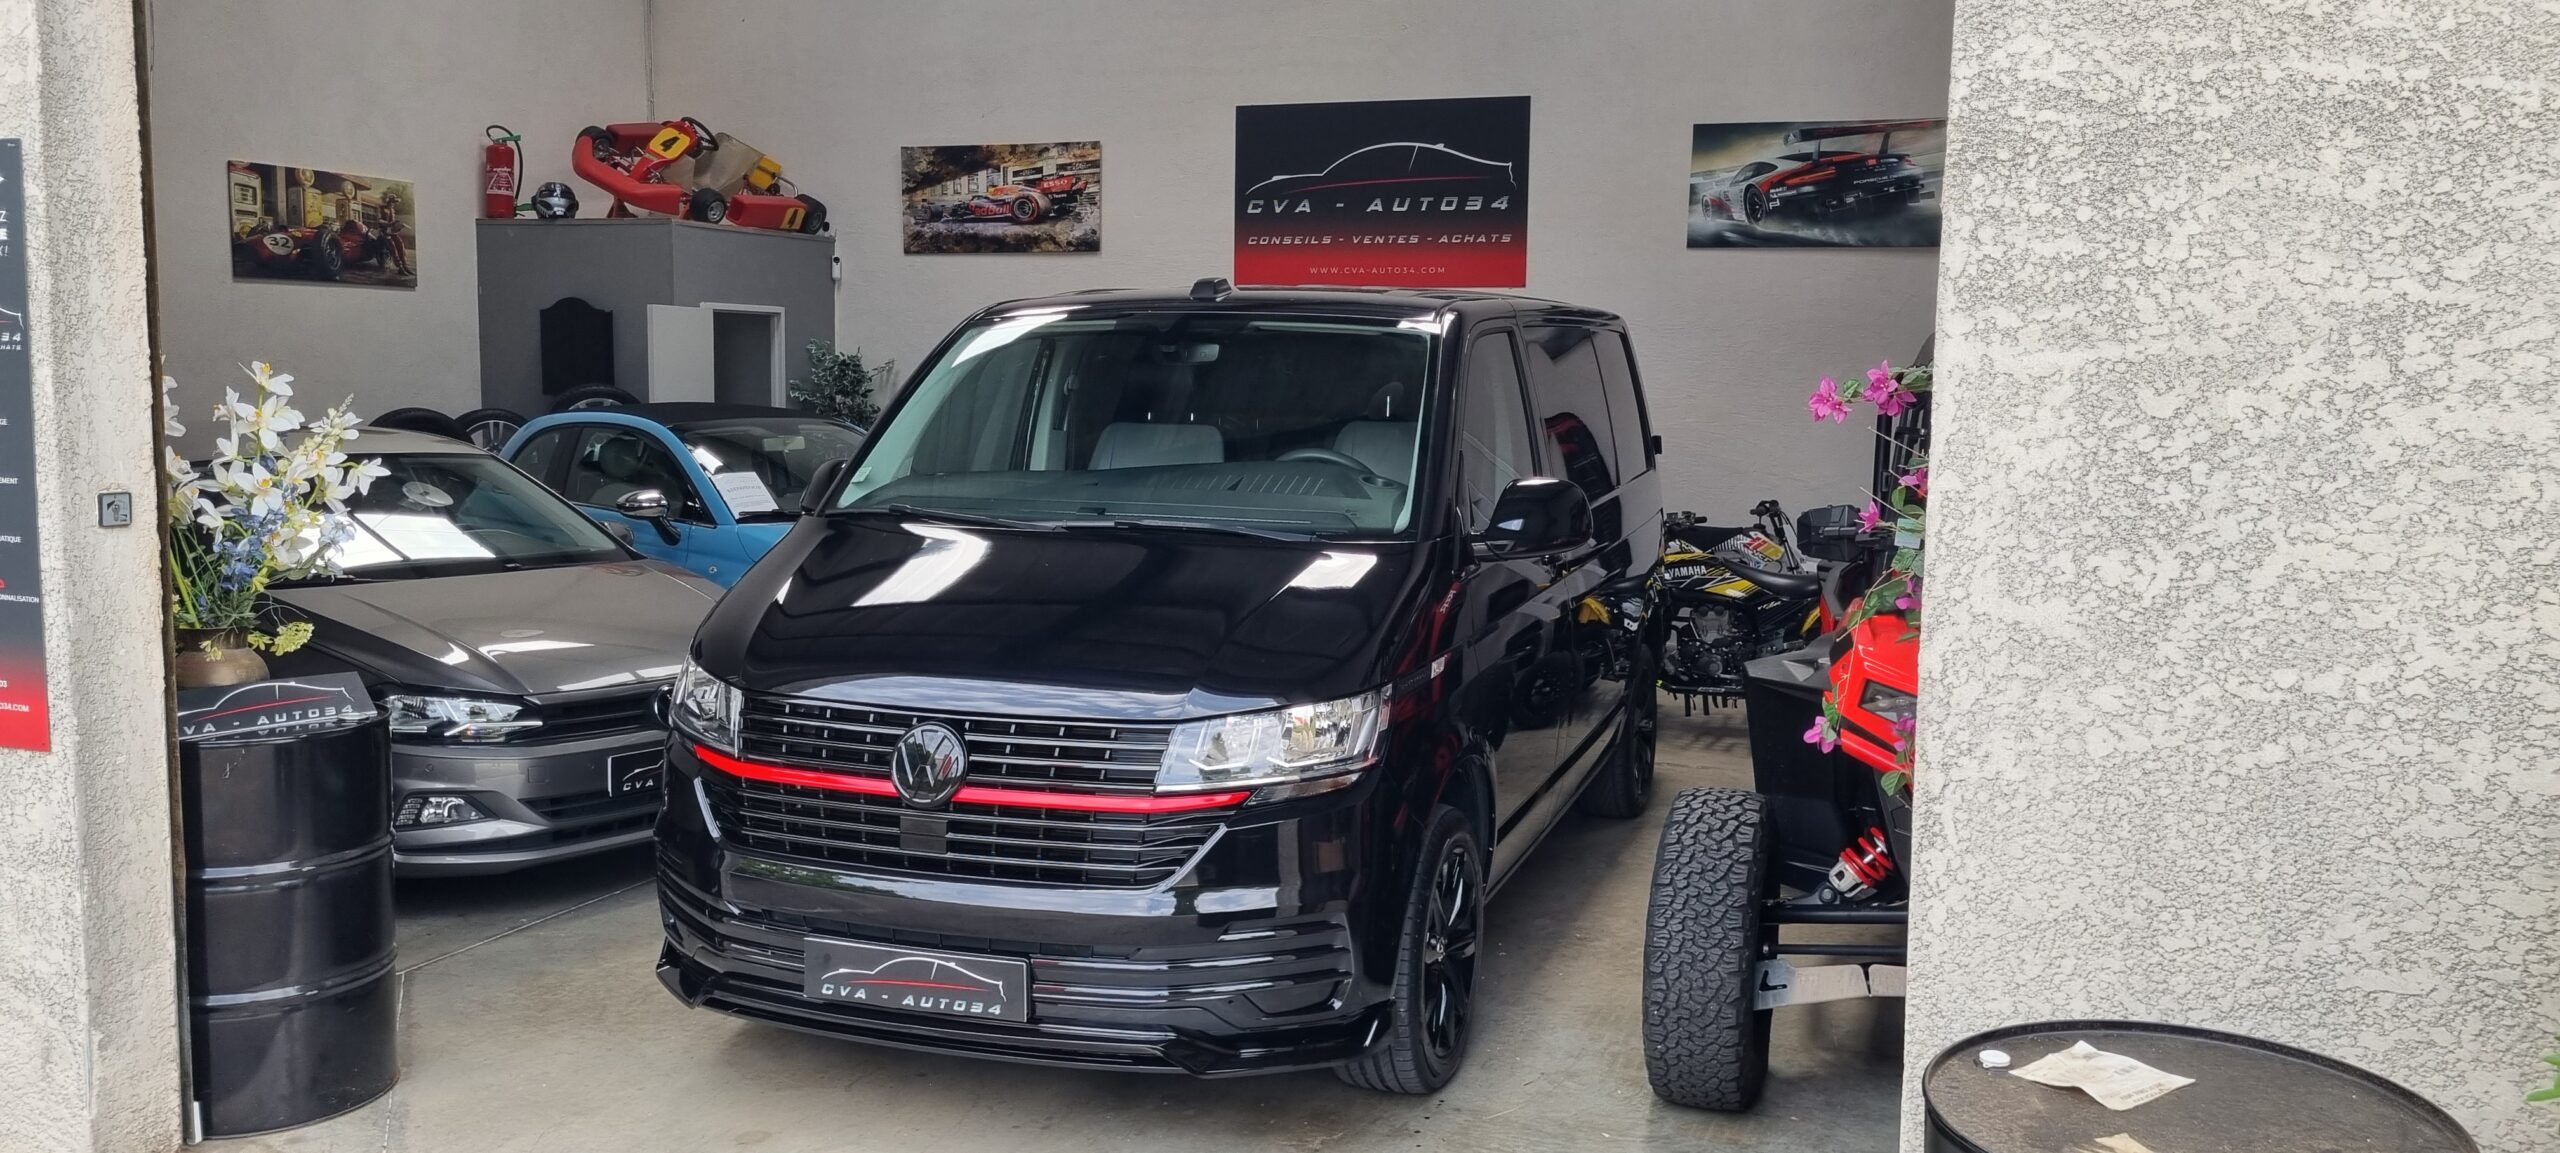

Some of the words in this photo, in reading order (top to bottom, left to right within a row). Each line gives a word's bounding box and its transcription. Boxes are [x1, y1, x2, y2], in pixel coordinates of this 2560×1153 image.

[659, 136, 680, 152] 4
[1246, 198, 1312, 214] CVA
[1365, 195, 1510, 213] AUTO34
[785, 208, 800, 229] 4
[268, 236, 291, 248] 32
[1247, 235, 1333, 245] CONSEILS
[1352, 234, 1420, 244] VENTES
[1437, 233, 1513, 243] ACHATS
[1309, 266, 1446, 275] WWW.CVA-AUTO34.COM
[1668, 565, 1707, 578] YAMAHA
[256, 704, 354, 726] AUTO34
[622, 779, 654, 791] CVA
[820, 983, 867, 999] CVA
[902, 994, 1002, 1015] AUTO34
